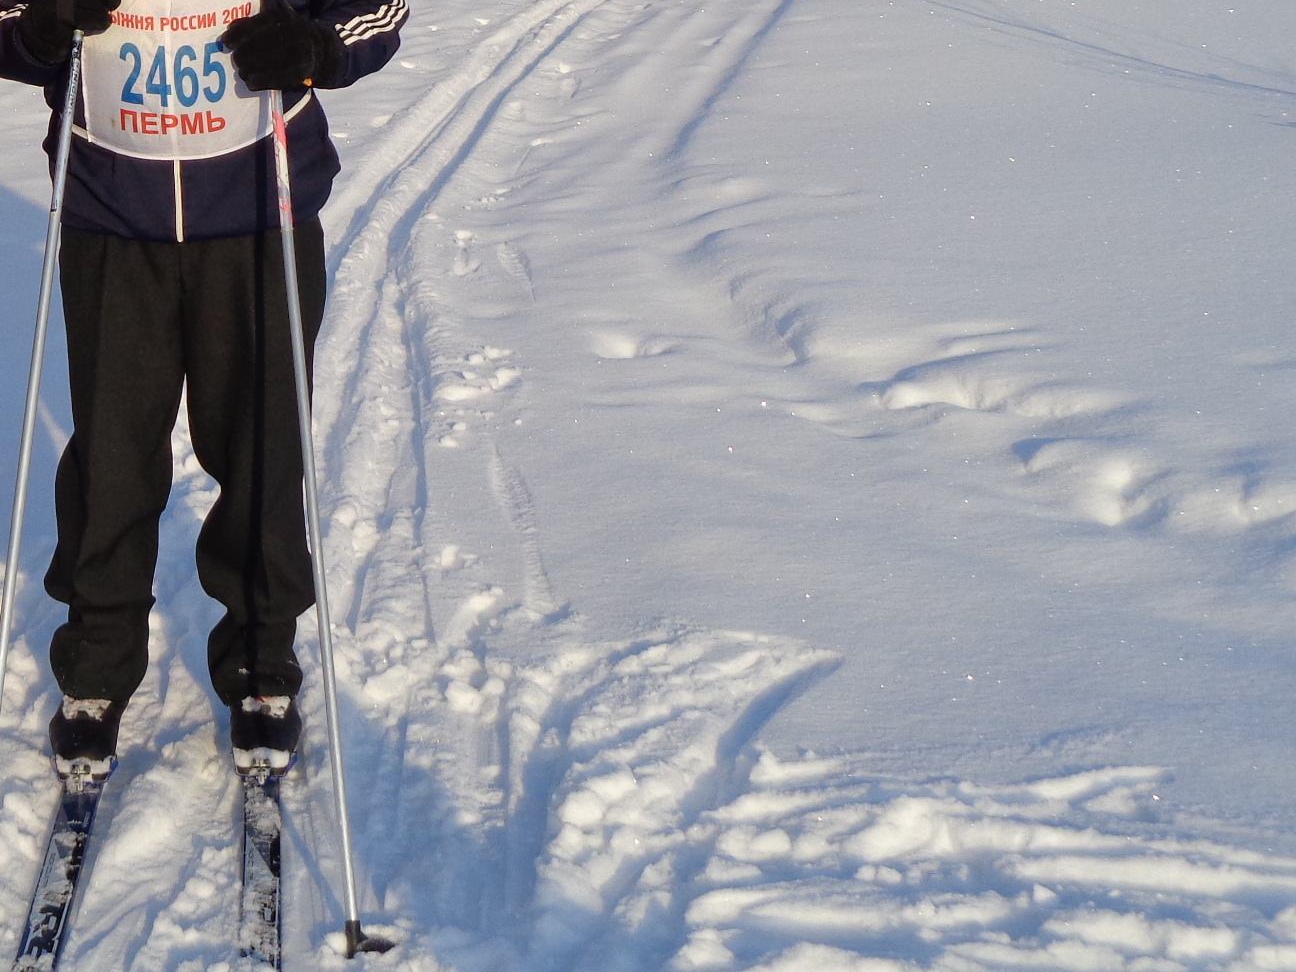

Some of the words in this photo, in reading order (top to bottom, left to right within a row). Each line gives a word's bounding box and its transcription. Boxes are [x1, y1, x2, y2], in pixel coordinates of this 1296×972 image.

[109, 11, 154, 31] ЫЖНЯ
[160, 12, 216, 31] РОССИИ
[222, 2, 252, 24] 2010
[119, 41, 226, 107] 2465
[120, 109, 226, 135] ПЕРМЬ
